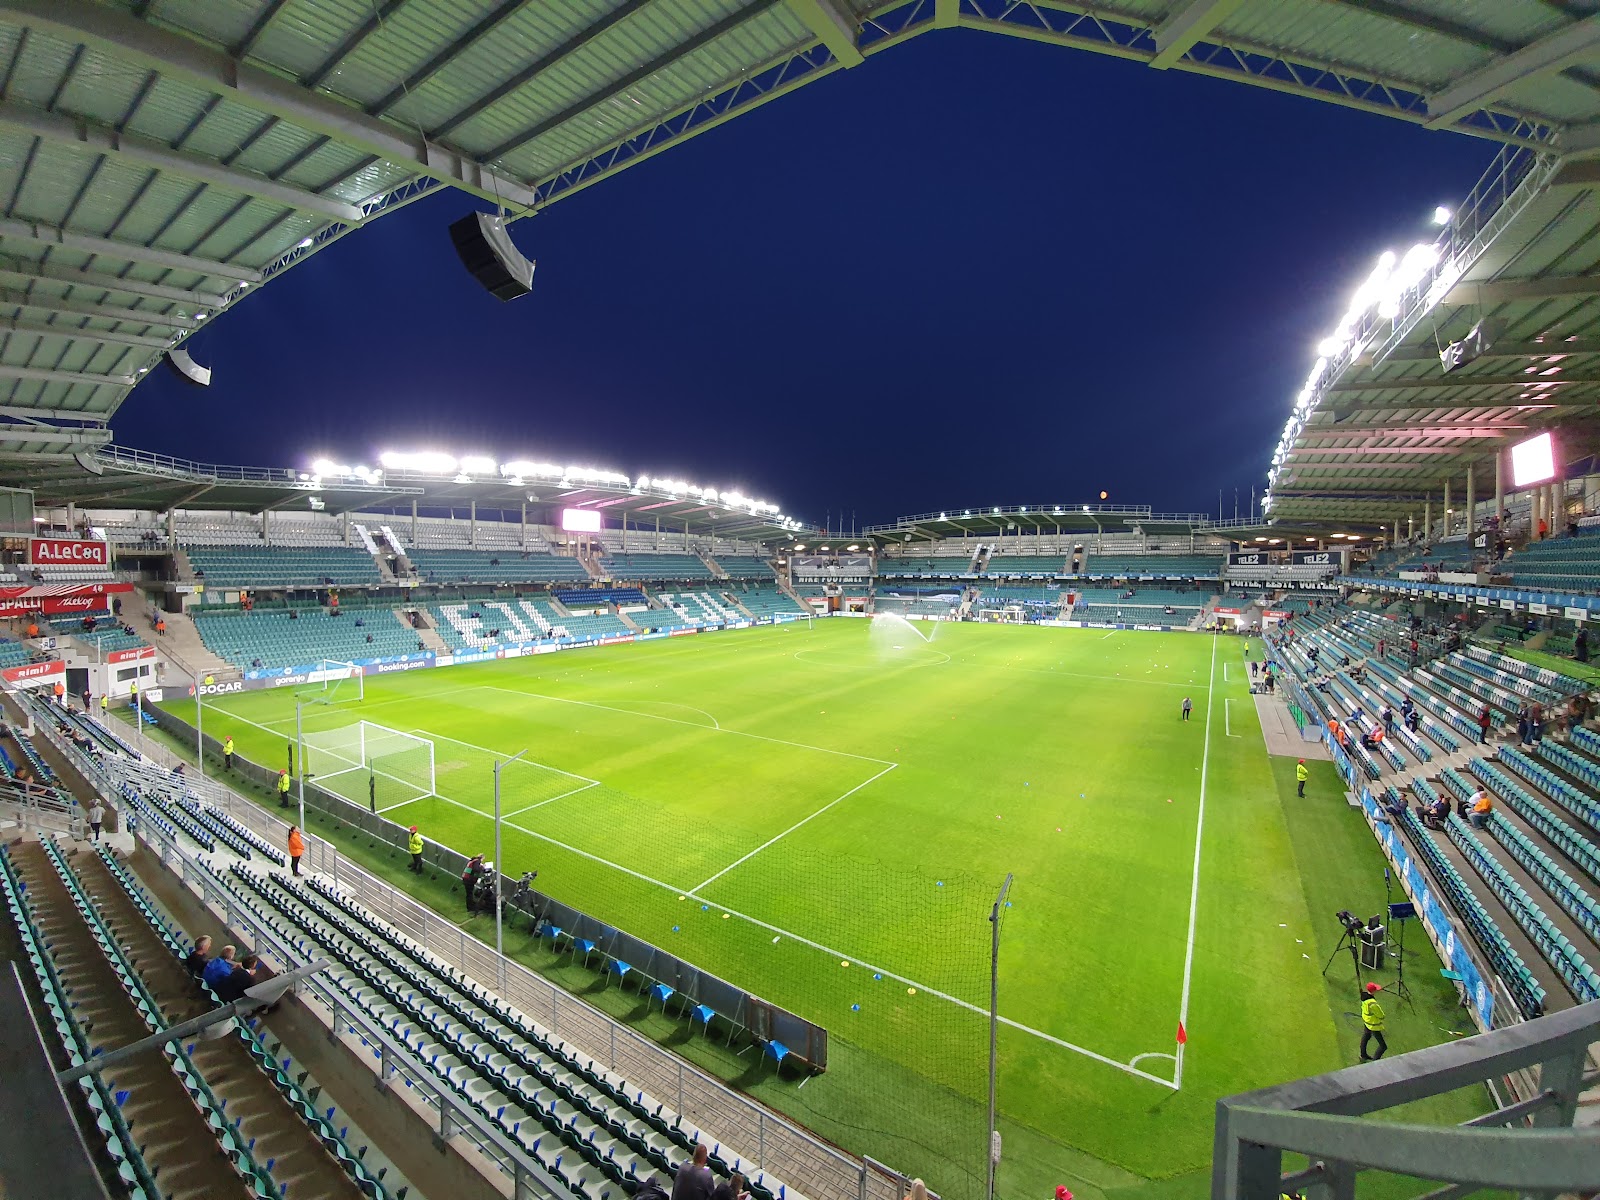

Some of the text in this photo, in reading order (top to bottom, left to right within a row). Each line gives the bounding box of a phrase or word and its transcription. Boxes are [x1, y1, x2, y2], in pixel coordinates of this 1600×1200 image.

[1237, 554, 1259, 564] TELE2
[1303, 553, 1330, 564] TELE2
[378, 660, 425, 672] Booking.com
[275, 675, 306, 686] gorenje
[199, 682, 242, 695] SOCAR
